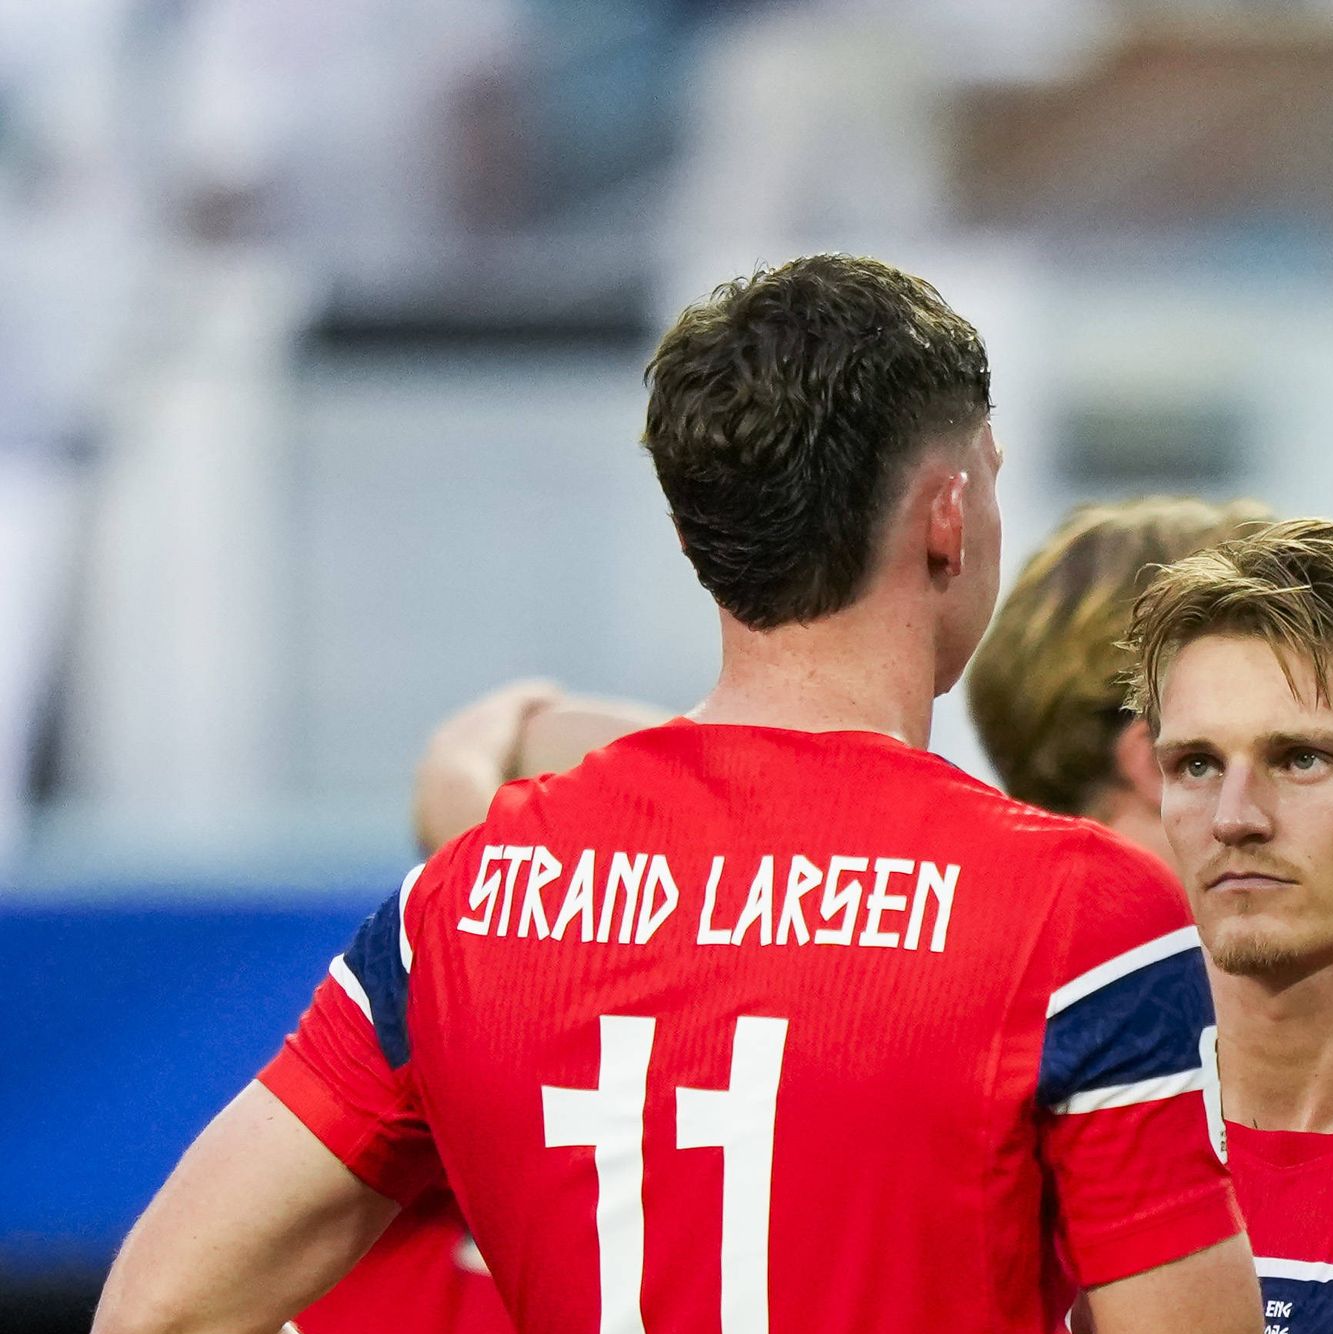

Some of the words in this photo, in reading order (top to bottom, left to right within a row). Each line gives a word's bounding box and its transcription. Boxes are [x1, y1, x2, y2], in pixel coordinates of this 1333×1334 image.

[457, 845, 680, 946] STRAND
[696, 853, 961, 953] LARSEN
[1265, 1300, 1293, 1319] ENG
